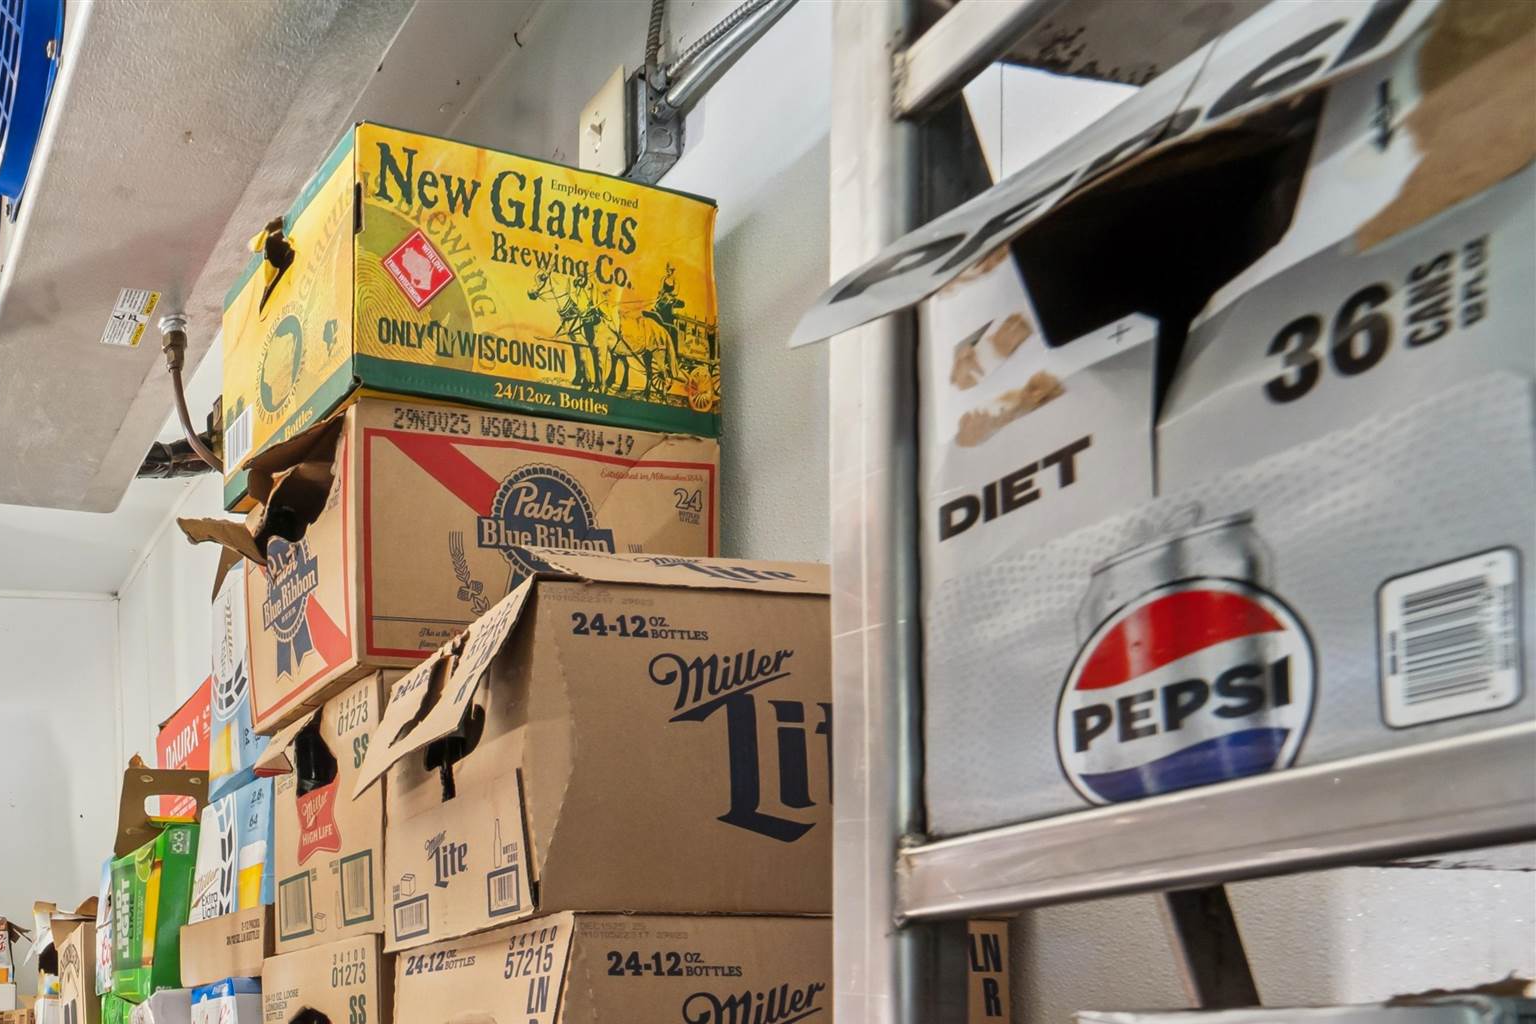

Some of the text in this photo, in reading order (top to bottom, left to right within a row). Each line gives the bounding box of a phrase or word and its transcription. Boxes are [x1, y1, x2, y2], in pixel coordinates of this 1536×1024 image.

[375, 142, 638, 256] New Glarus
[550, 179, 639, 210] Employee Owned
[491, 232, 633, 289] Brewing Co.
[1404, 250, 1454, 349] CANS
[377, 316, 565, 374] ONLY WISCONSIN
[1266, 282, 1390, 405] 36
[494, 381, 609, 416] 24/12oz. Bottles
[514, 480, 577, 525] Pabst
[674, 488, 704, 513] 24
[940, 434, 1093, 544] DIET
[482, 519, 611, 553] Blue Ribbon
[263, 569, 317, 628] Blue Ribbon
[571, 611, 670, 638] 24-12 OZ.
[651, 629, 710, 641] BOTTLES
[648, 648, 795, 711] Miller
[337, 700, 369, 737] 01273
[1074, 655, 1293, 754] PEPSI
[164, 717, 200, 768] DAURA
[301, 790, 329, 829] Miller
[301, 823, 333, 845] HIGH LIFE
[434, 840, 468, 889] Lite
[201, 889, 218, 909] Extra
[405, 951, 446, 976] 24-12
[444, 955, 477, 970] BOTTLES
[504, 943, 555, 981] 57215
[607, 951, 705, 977] 24-12 OZ.
[685, 965, 743, 977] BOTTLES
[969, 934, 1003, 974] LN
[332, 963, 366, 988] 01273
[527, 976, 551, 1015] LN
[984, 979, 1003, 1018] R
